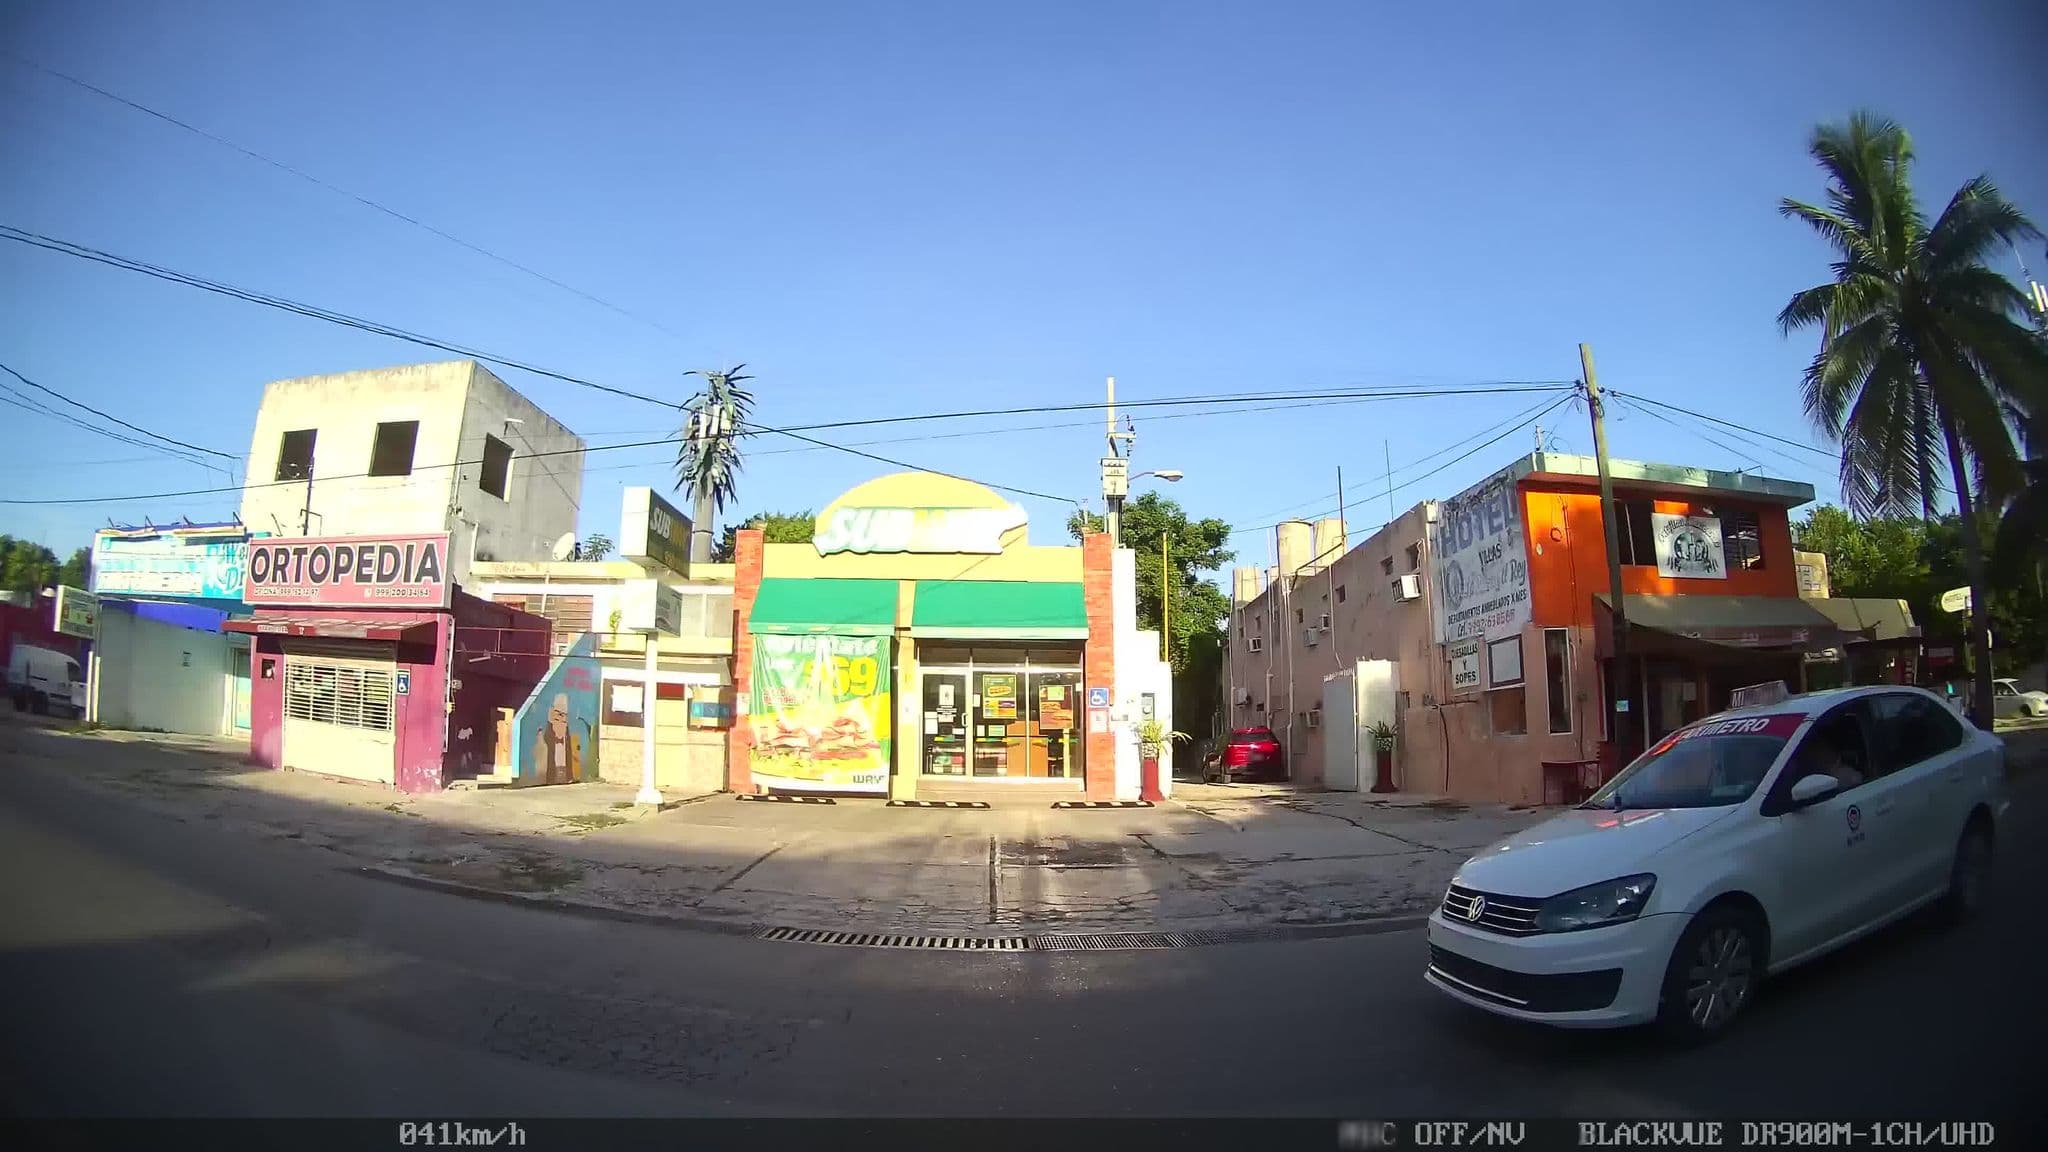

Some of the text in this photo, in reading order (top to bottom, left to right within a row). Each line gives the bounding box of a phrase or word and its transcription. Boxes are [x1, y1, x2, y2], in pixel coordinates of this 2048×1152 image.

[1441, 492, 1514, 557] HOTEL
[250, 543, 442, 585] ORTOPEDIA
[1478, 543, 1502, 565] VILLAS
[1462, 659, 1467, 671] Y
[1455, 670, 1477, 685] SOPES
